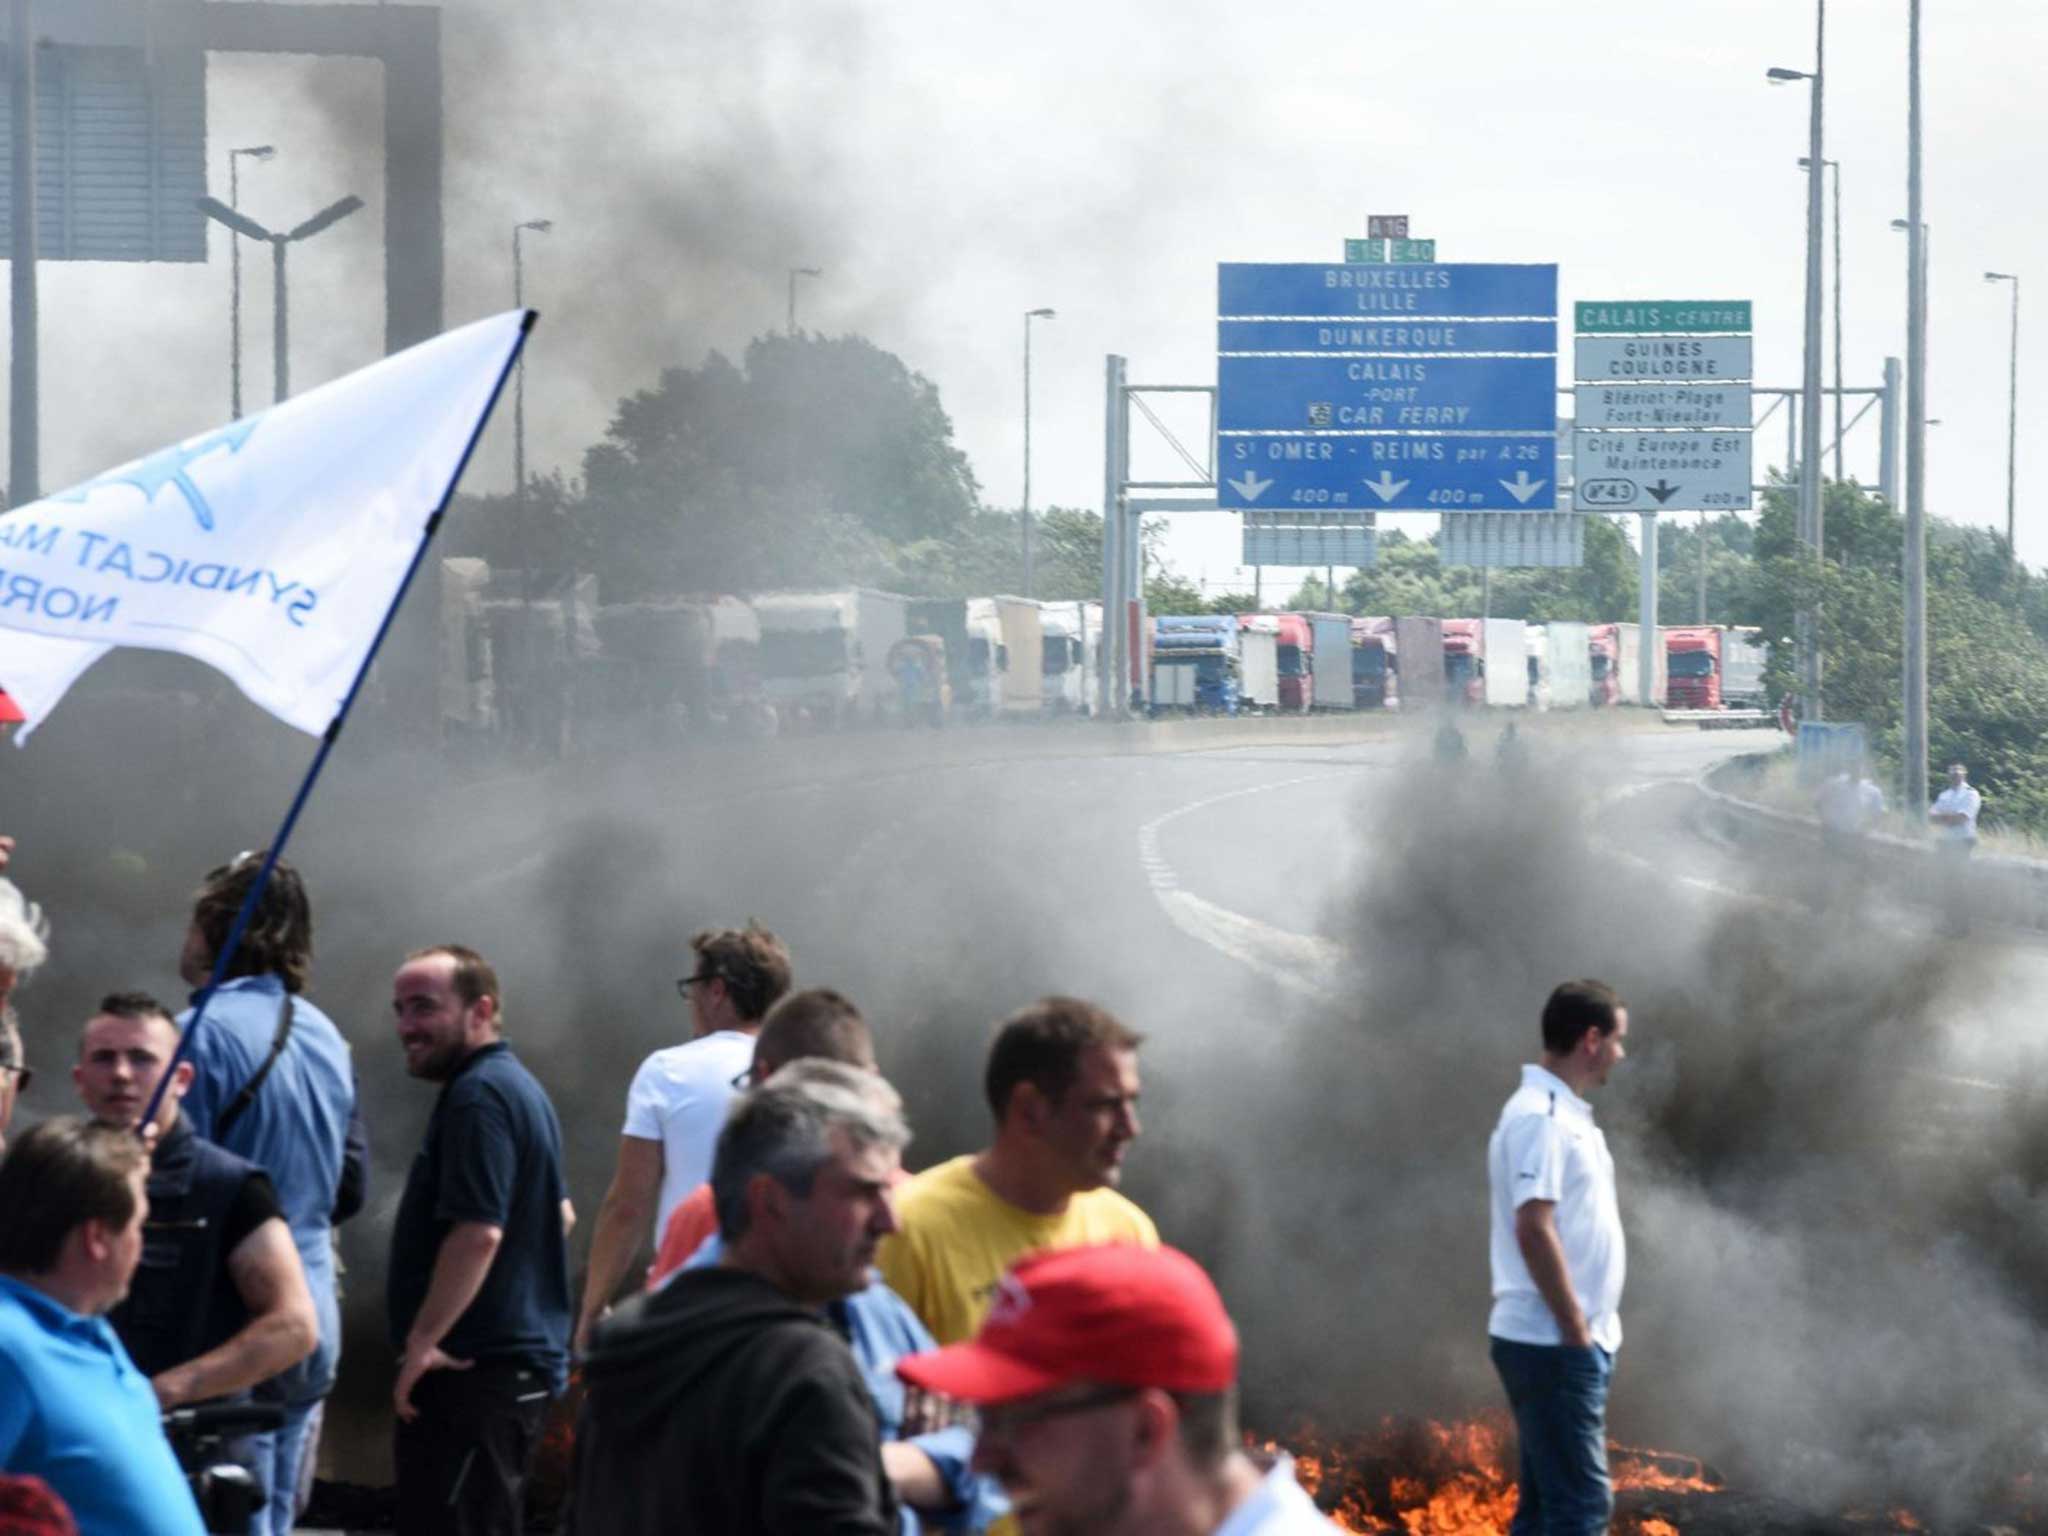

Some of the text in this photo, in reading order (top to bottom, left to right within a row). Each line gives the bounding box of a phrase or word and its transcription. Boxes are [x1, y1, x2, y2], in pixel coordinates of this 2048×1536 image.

[1325, 270, 1451, 289] BRUXELLES
[1358, 293, 1416, 311] LILLE
[1319, 328, 1456, 347] DUNKERQUE
[1348, 363, 1427, 382] CALAIS
[1609, 360, 1718, 375] COULOGNE
[1338, 406, 1470, 424] CAR FERRY
[1268, 442, 1334, 460] OMER
[1372, 441, 1446, 460] REIMS
[1456, 447, 1487, 464] par
[1637, 437, 1701, 454] Europe
[1711, 437, 1742, 452] Est
[1605, 455, 1723, 471] Maintenance
[1291, 488, 1329, 502] 400
[1427, 488, 1466, 503] 400
